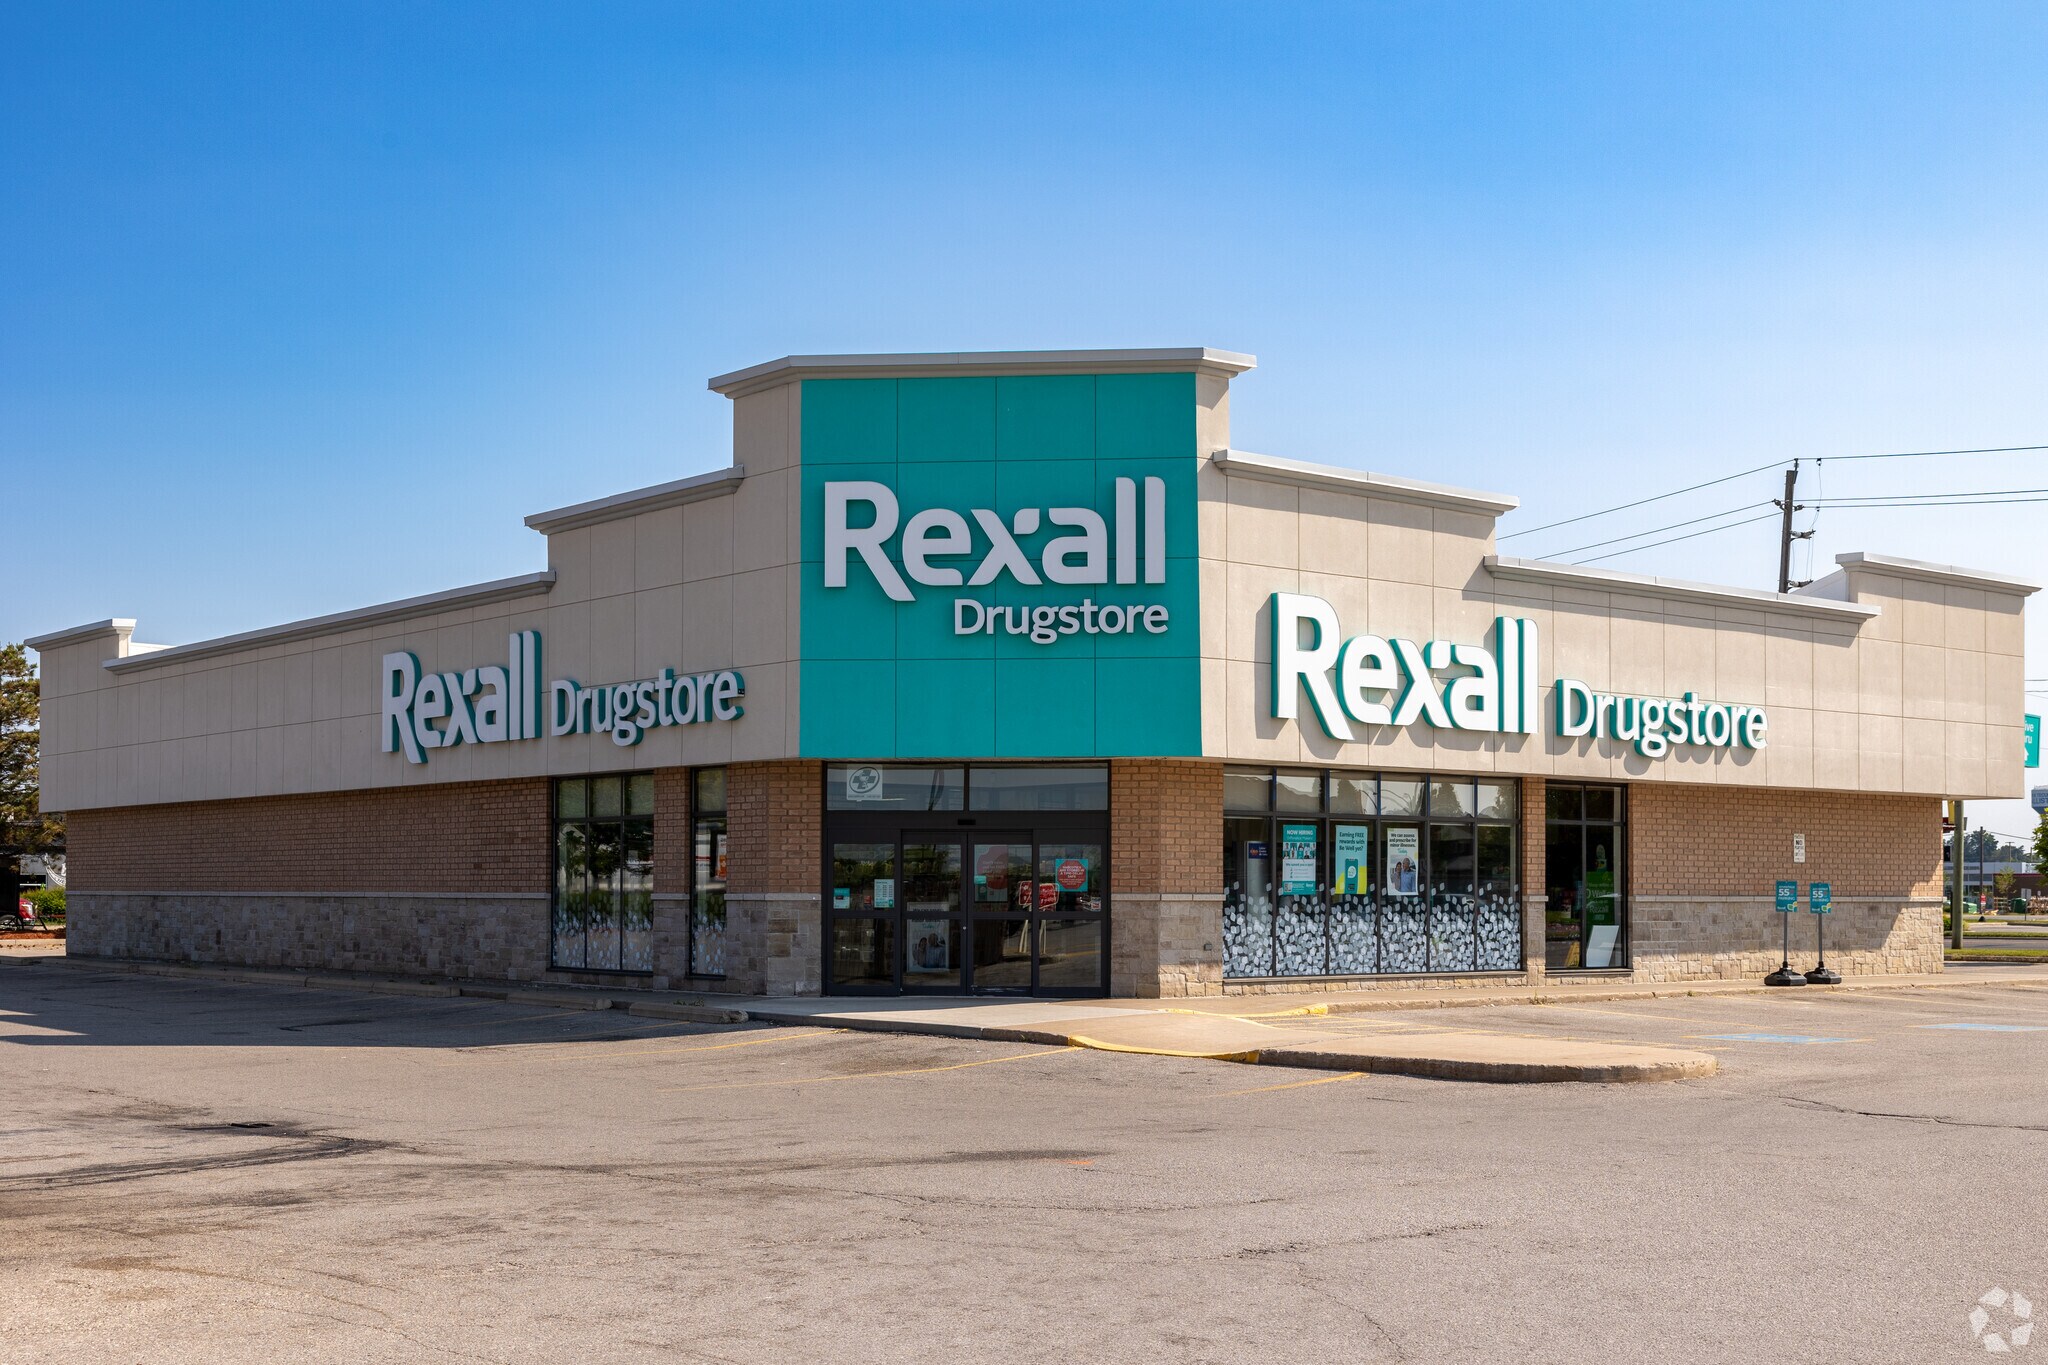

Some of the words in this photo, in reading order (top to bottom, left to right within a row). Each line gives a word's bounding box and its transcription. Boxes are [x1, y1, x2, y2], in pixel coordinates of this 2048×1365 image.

[824, 476, 1166, 602] Rexall
[954, 598, 1169, 645] Drugstore
[1271, 591, 1539, 741] Rexall
[1556, 678, 1768, 758] Drugstore
[382, 630, 543, 764] Rexall
[551, 667, 745, 748] Drugstore
